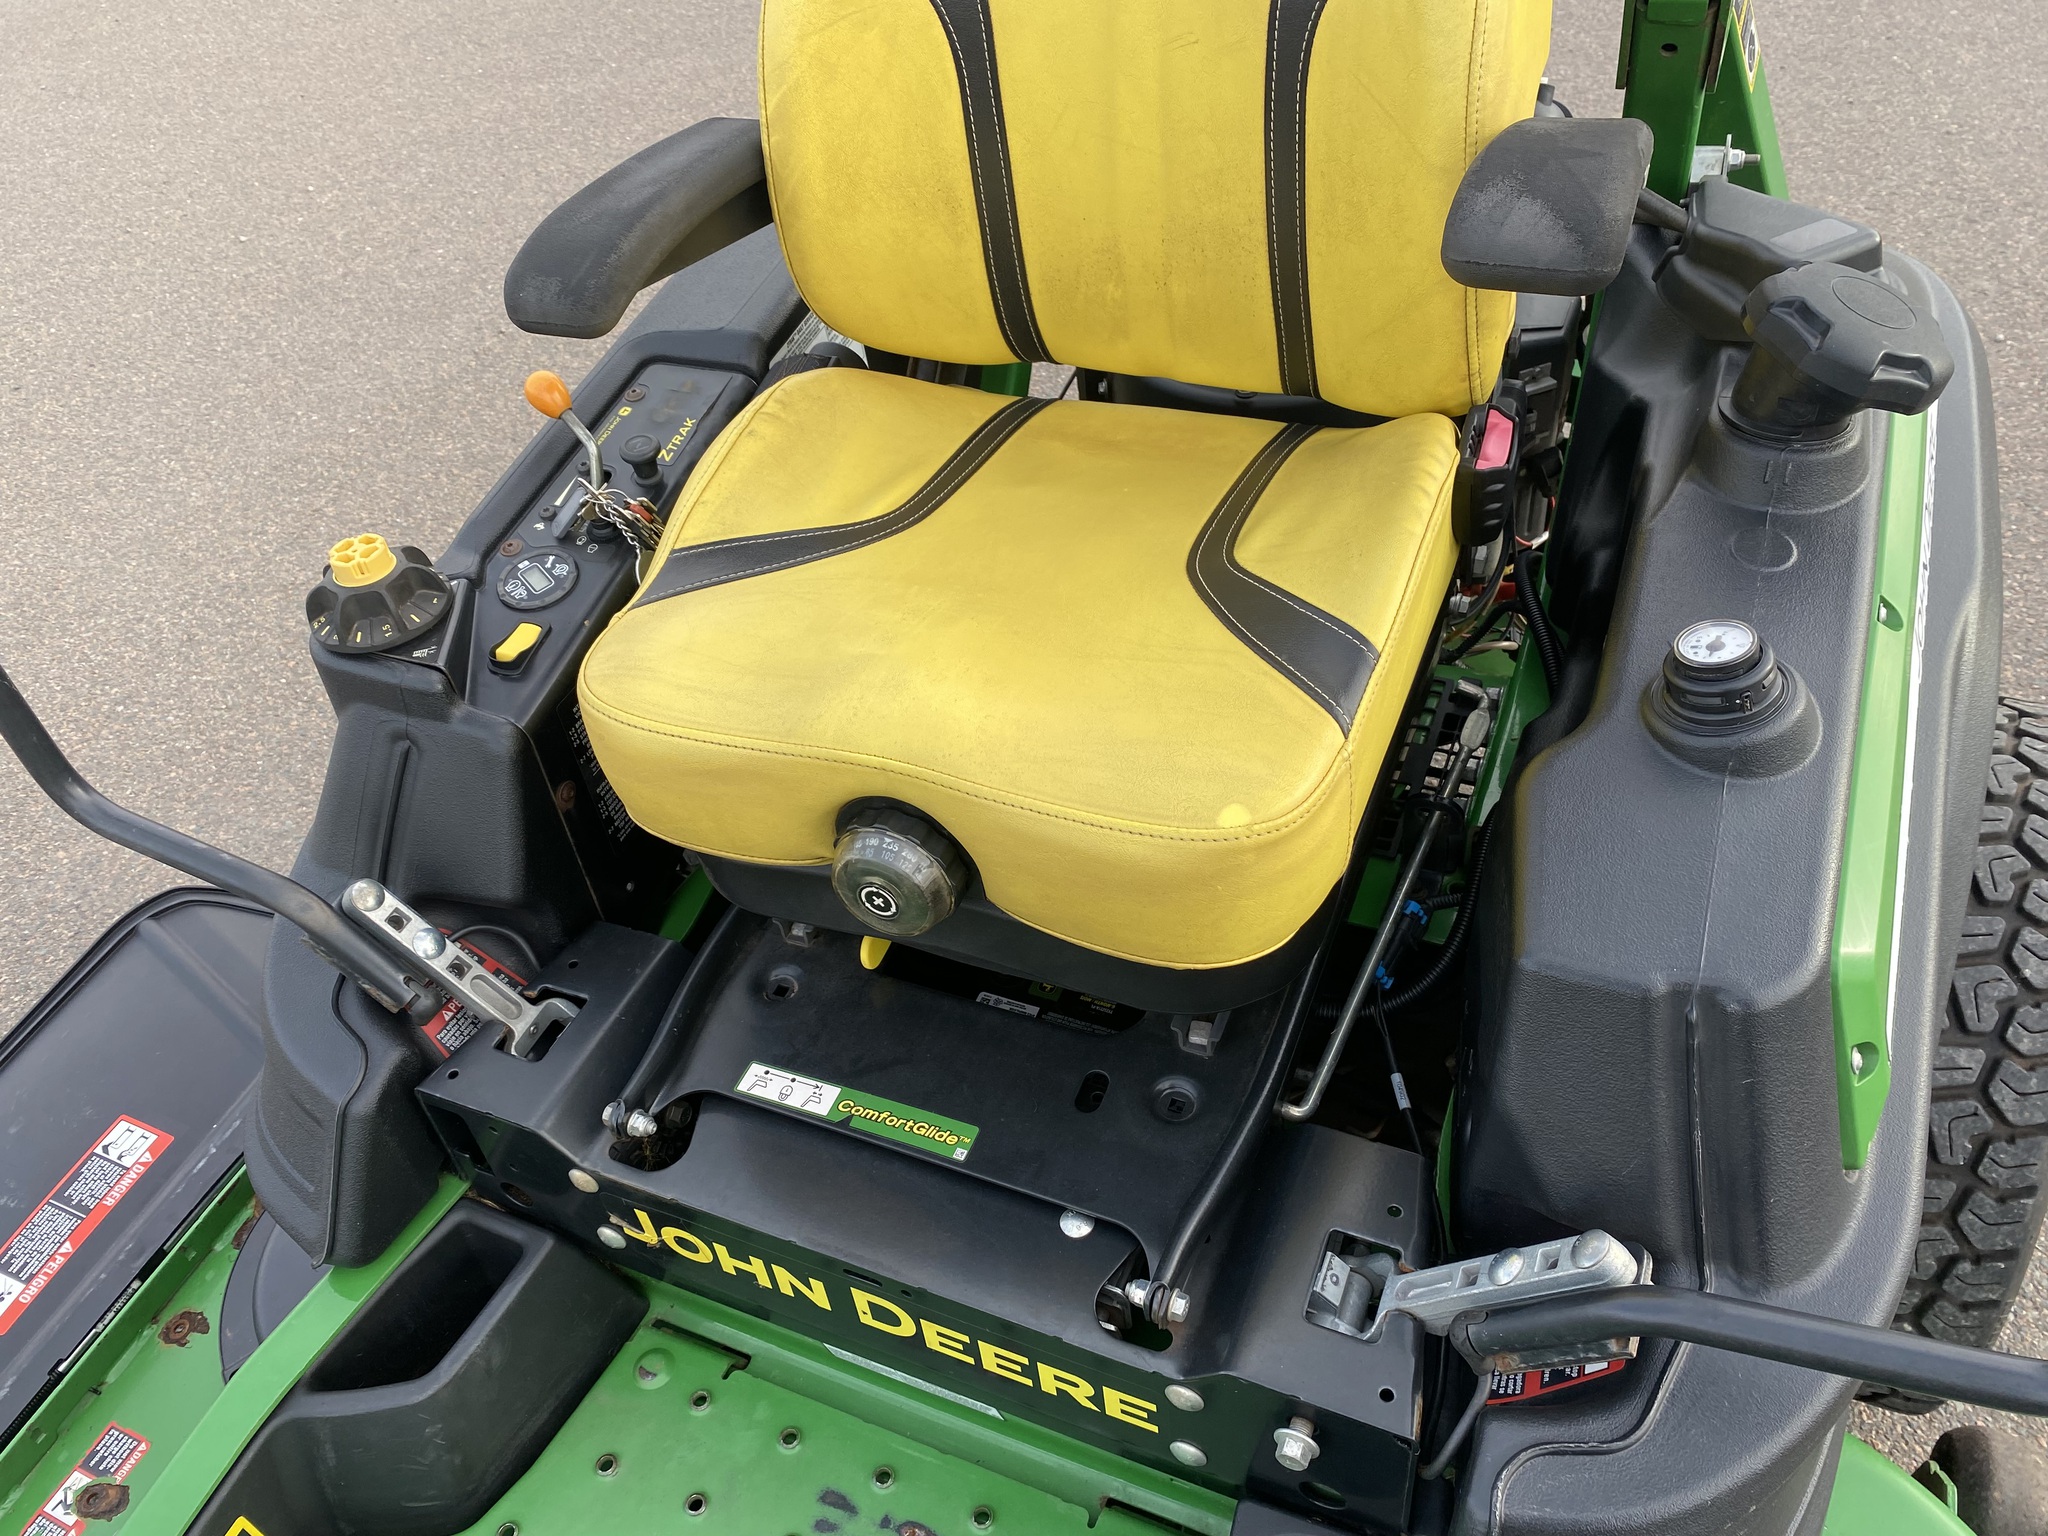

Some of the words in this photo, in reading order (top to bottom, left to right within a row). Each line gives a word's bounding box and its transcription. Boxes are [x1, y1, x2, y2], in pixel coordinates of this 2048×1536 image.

[657, 417, 697, 461] ZTRAK
[865, 838, 879, 846] 190
[101, 1161, 145, 1208] DANGER
[16, 1253, 65, 1305] PELIGRO
[622, 1207, 832, 1311] JOHN
[850, 1286, 1159, 1433] DEERE
[111, 1450, 142, 1484] DANGE
